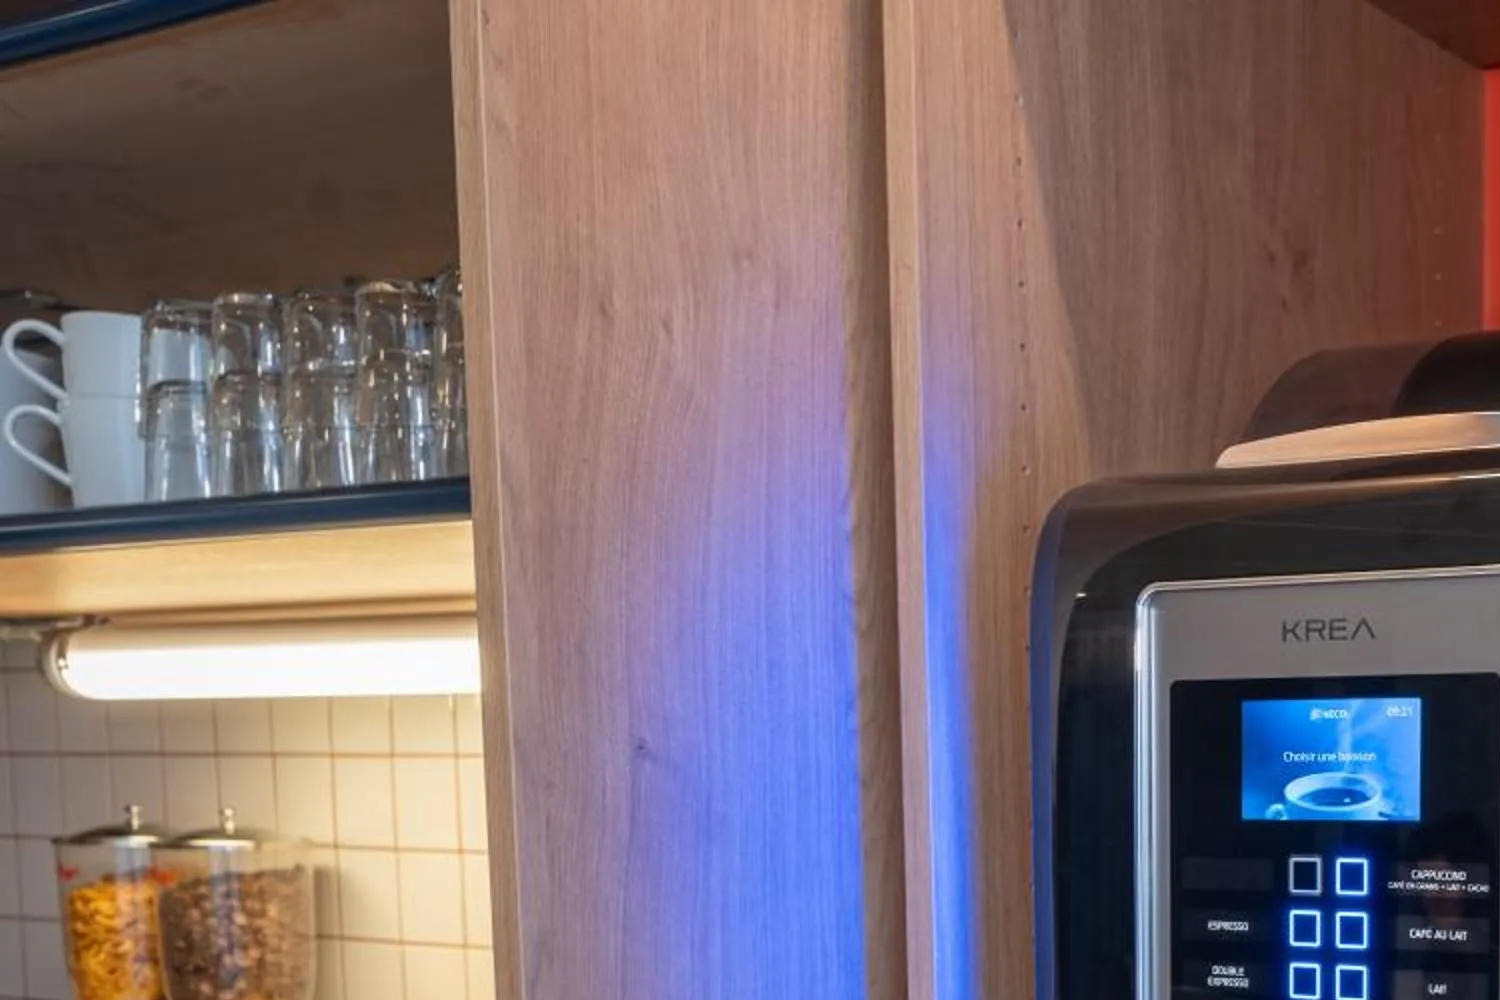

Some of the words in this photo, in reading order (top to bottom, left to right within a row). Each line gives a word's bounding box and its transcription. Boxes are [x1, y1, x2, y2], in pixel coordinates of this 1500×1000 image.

[1281, 616, 1377, 643] KREA
[1410, 869, 1467, 881] CAPPUCCINO
[1207, 920, 1249, 931] ESPRESSO
[1448, 930, 1468, 941] LAIT
